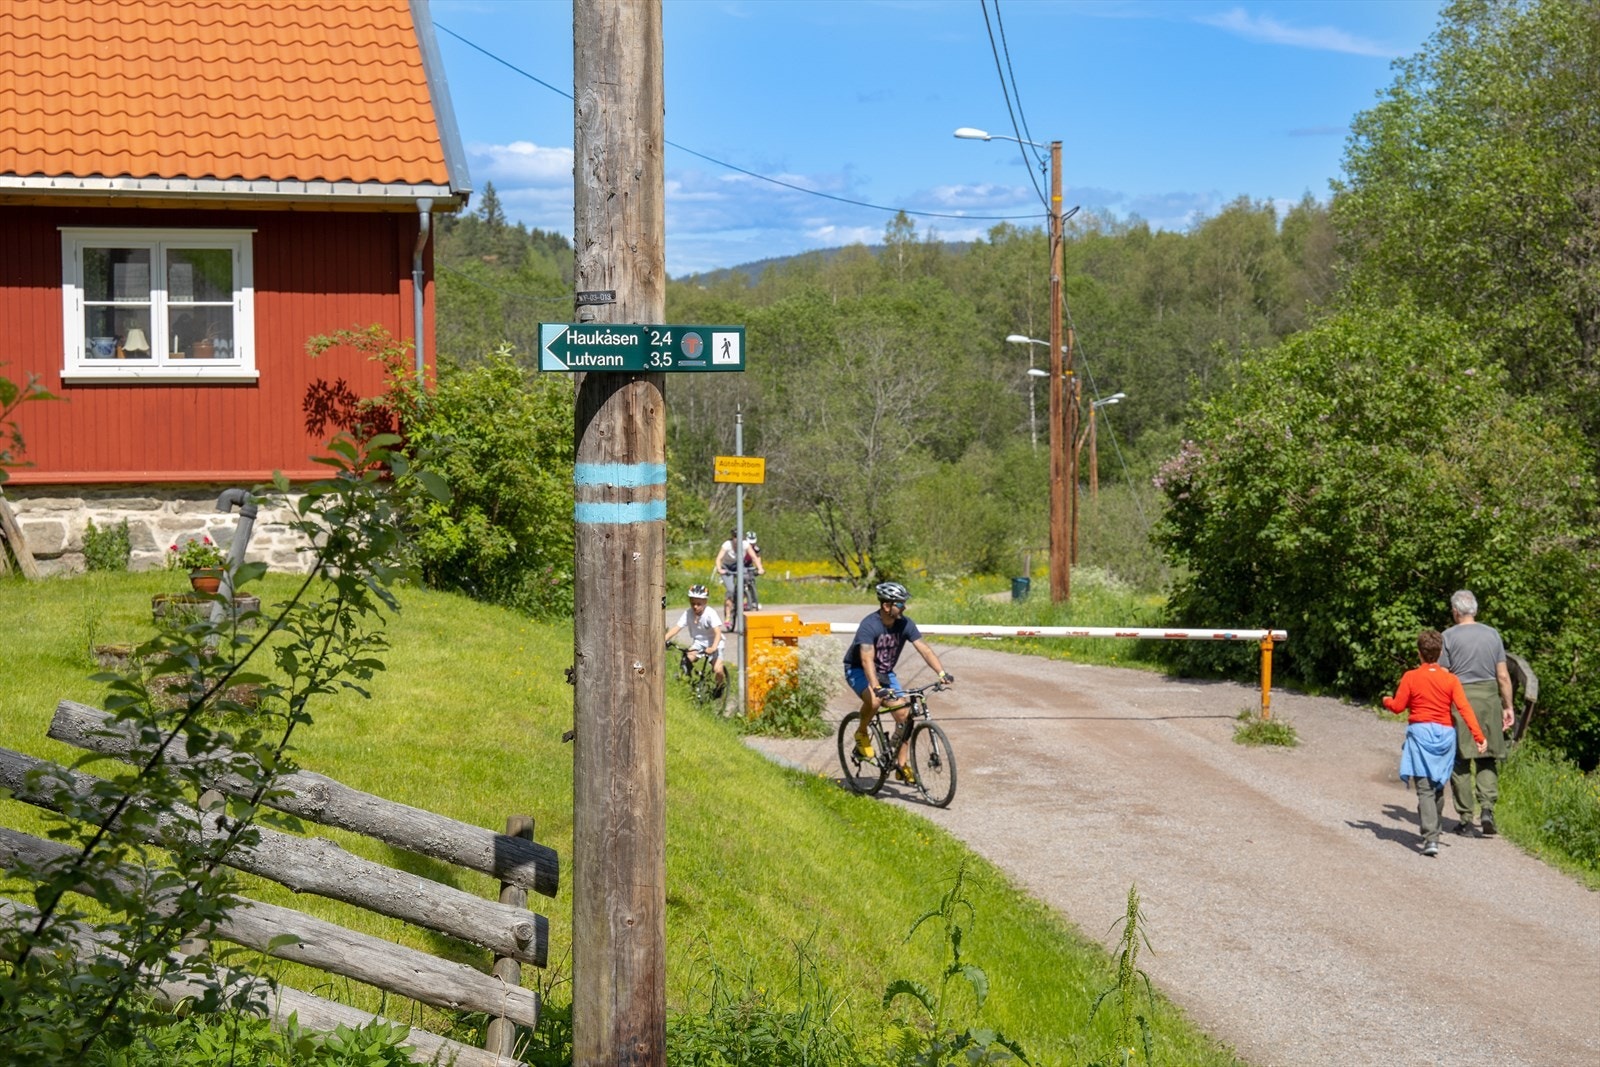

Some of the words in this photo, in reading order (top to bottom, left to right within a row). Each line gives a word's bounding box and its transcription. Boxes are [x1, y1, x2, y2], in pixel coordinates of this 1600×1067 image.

[566, 328, 638, 345] Haukåsen
[650, 331, 673, 347] 2,4
[566, 352, 624, 366] Lutvann
[650, 352, 673, 367] 3,5
